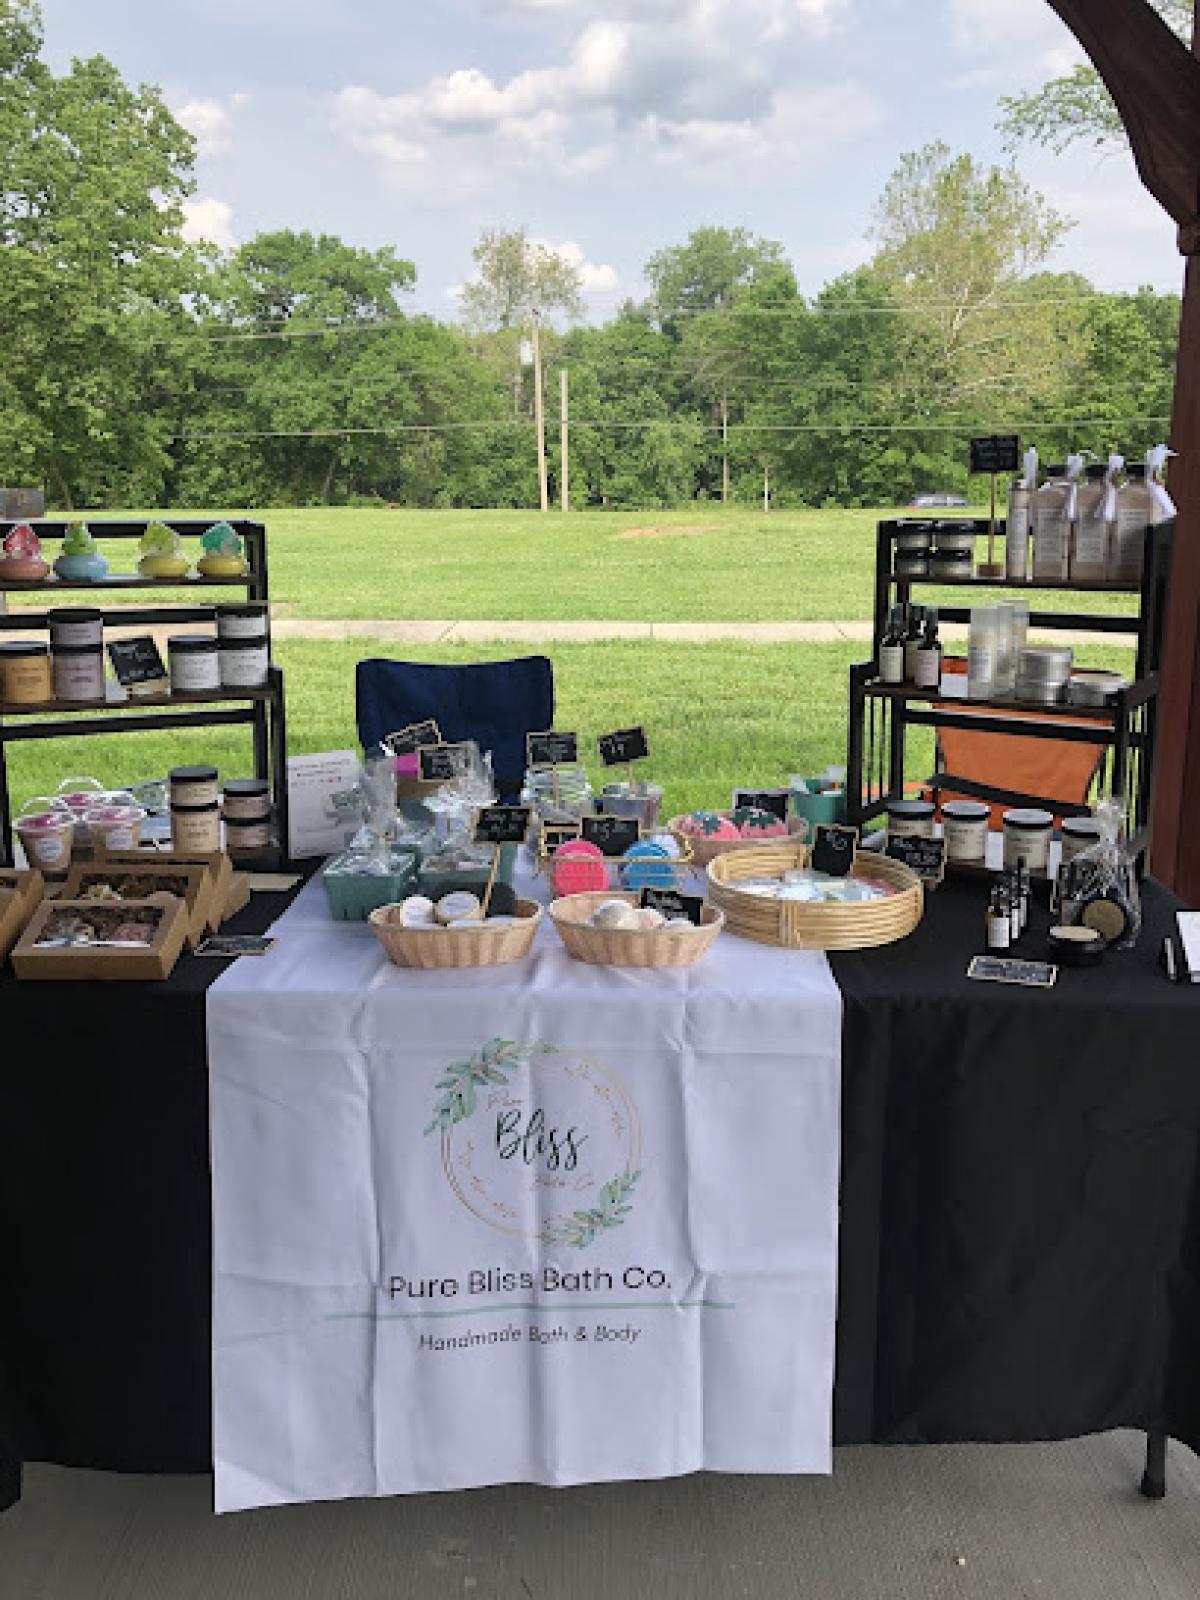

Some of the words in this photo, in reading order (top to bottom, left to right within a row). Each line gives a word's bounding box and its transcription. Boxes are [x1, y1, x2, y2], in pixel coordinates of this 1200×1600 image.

[496, 1108, 589, 1171] Bliss
[389, 1275, 459, 1299] Pure
[468, 1267, 534, 1295] Bliss
[543, 1266, 614, 1292] Bath
[623, 1265, 672, 1290] Co.
[418, 1323, 522, 1350] Handmade
[528, 1325, 569, 1345] Bath
[575, 1325, 588, 1342] &
[593, 1323, 642, 1344] Body
